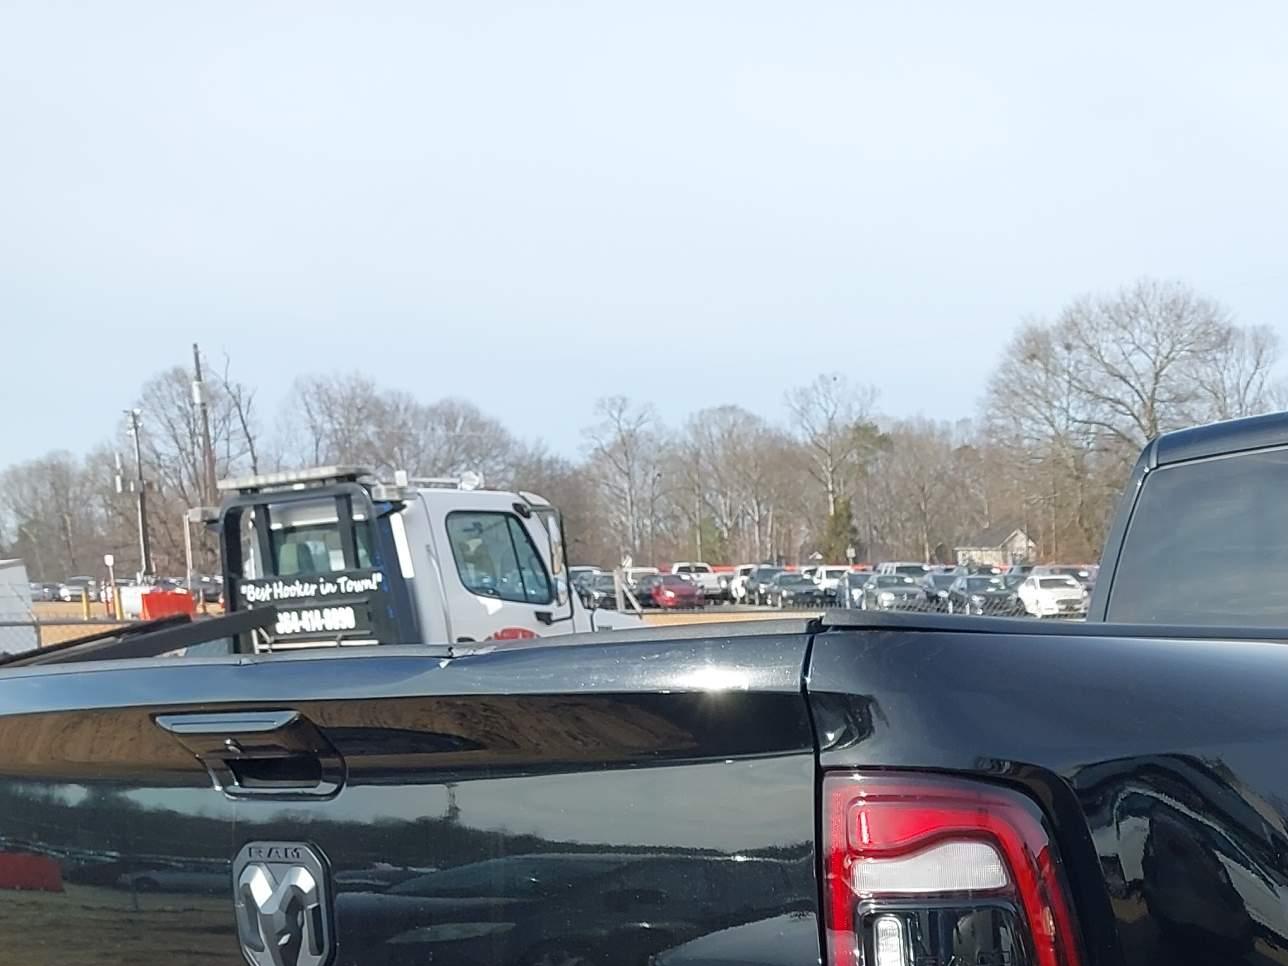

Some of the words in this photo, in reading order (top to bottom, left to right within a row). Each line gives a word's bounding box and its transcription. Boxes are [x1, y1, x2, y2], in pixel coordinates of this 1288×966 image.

[273, 579, 317, 599] Hooker
[319, 577, 338, 595] in
[248, 847, 302, 859] RAM
